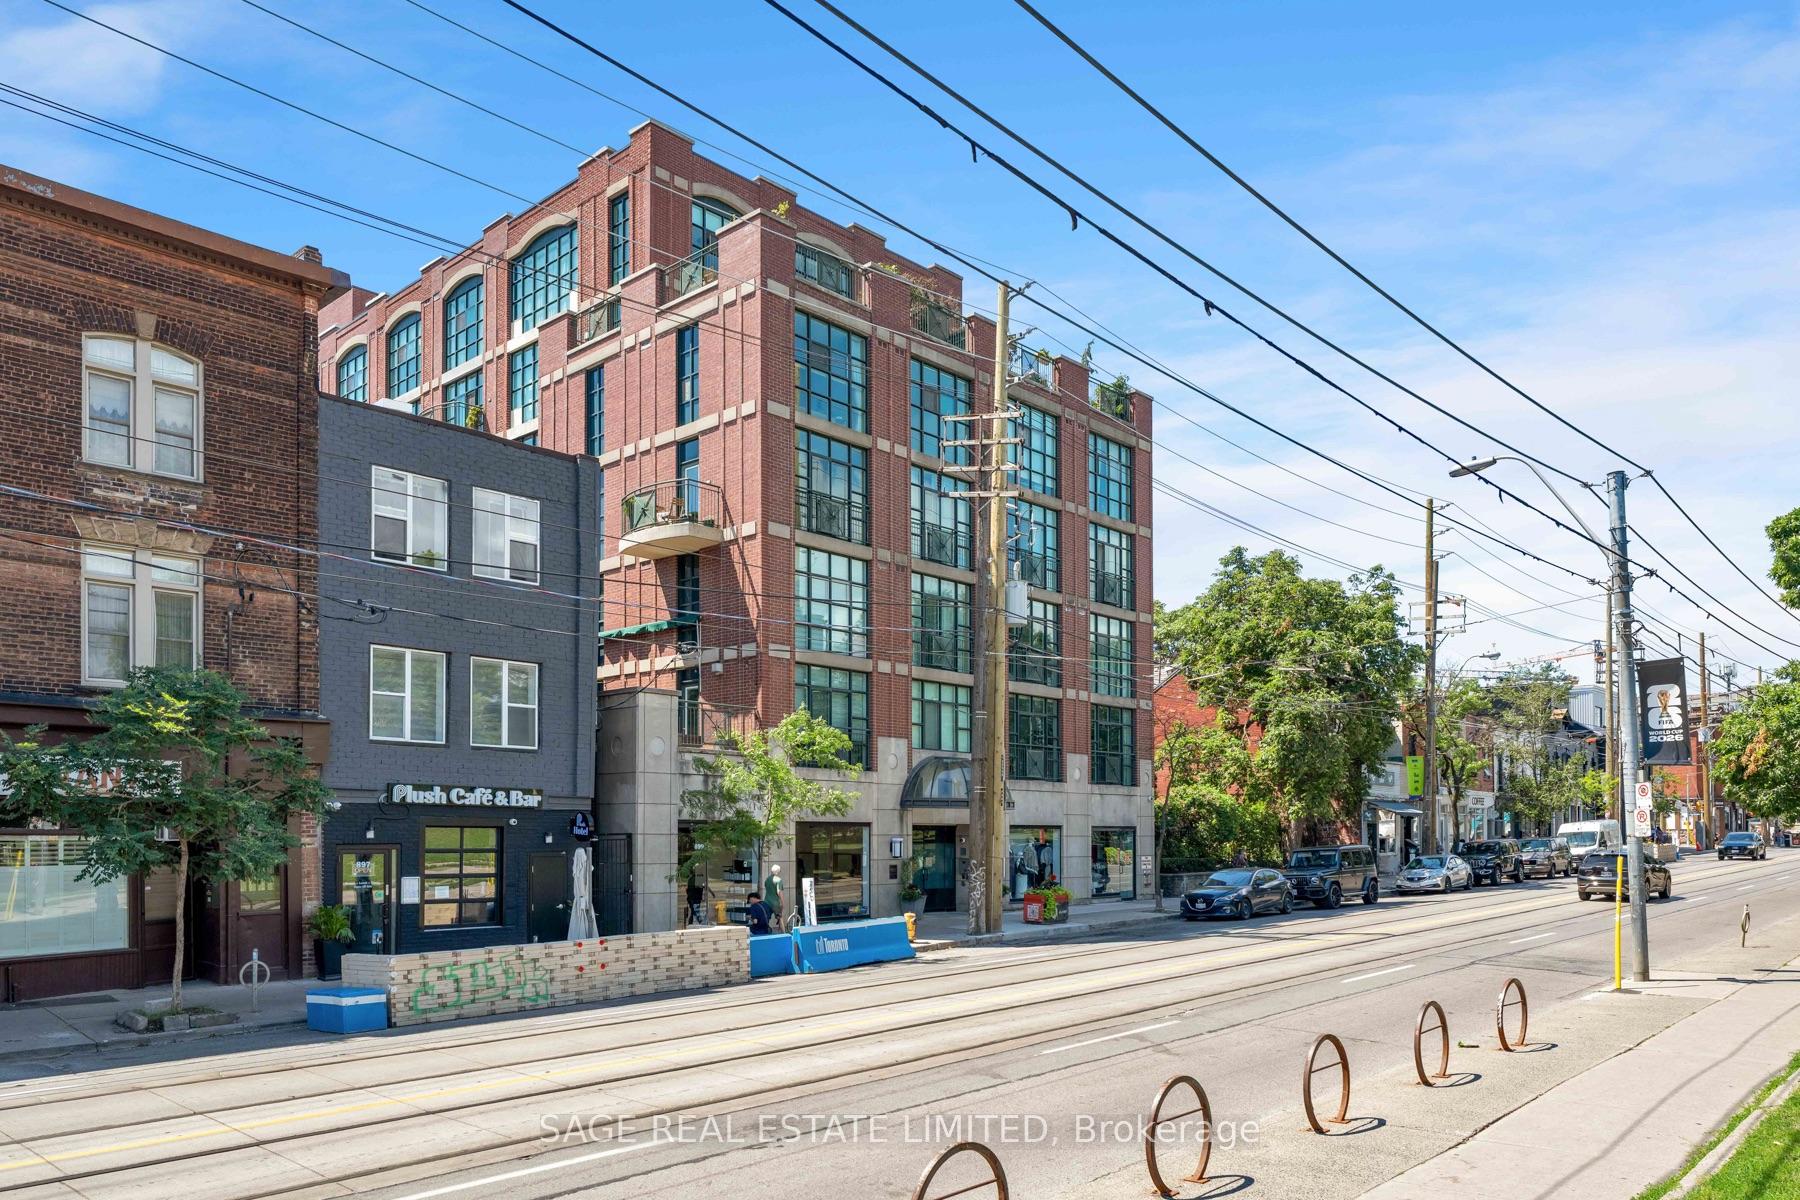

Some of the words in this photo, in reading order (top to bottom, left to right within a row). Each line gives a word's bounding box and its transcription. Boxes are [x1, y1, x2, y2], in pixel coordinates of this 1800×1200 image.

[1648, 734, 1684, 743] 2026
[392, 784, 447, 804] Plush
[449, 787, 493, 806] Café
[495, 790, 509, 807] &
[510, 790, 542, 807] Bar
[573, 825, 589, 836] Hotel
